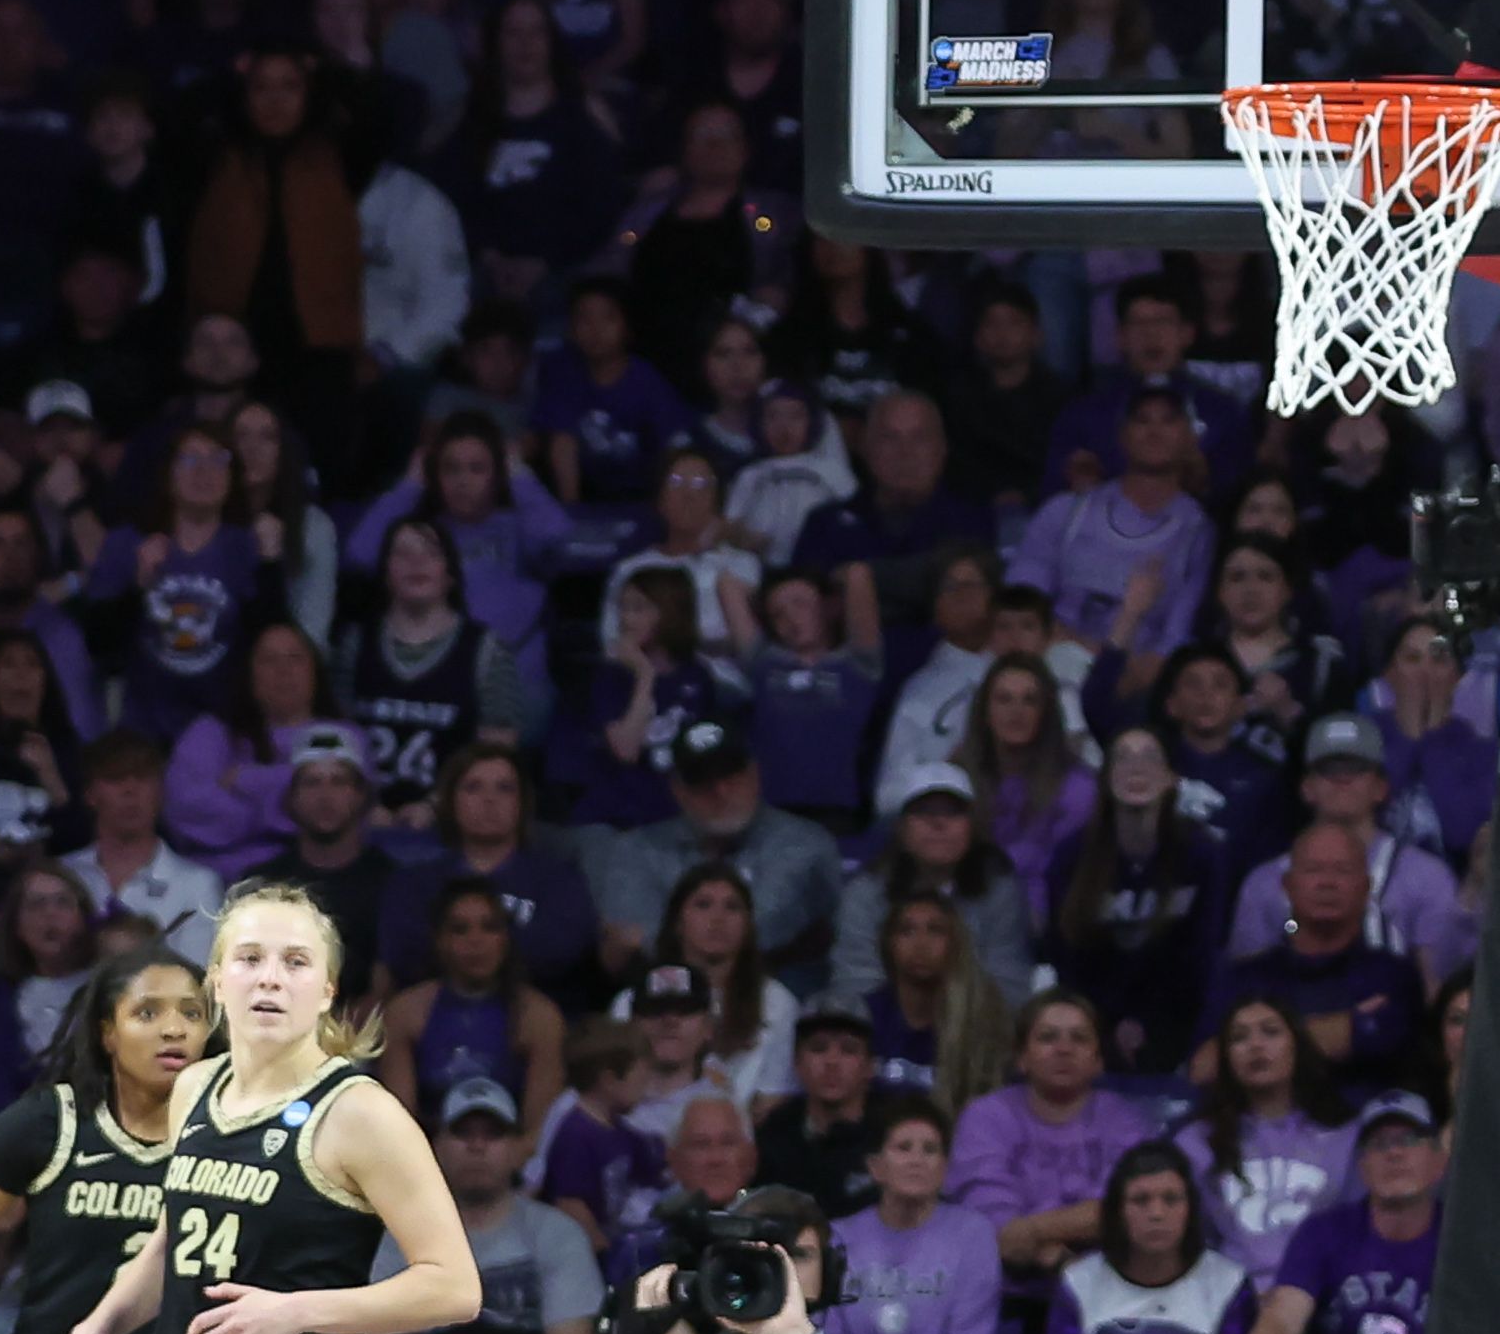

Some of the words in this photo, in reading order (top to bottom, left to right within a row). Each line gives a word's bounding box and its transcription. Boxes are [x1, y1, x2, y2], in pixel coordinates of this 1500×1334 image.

[952, 41, 1017, 60] MARCH
[959, 60, 1047, 82] MADNESS
[885, 170, 993, 195] SPALDING
[65, 1180, 164, 1220] COLOR
[173, 1207, 240, 1280] 24
